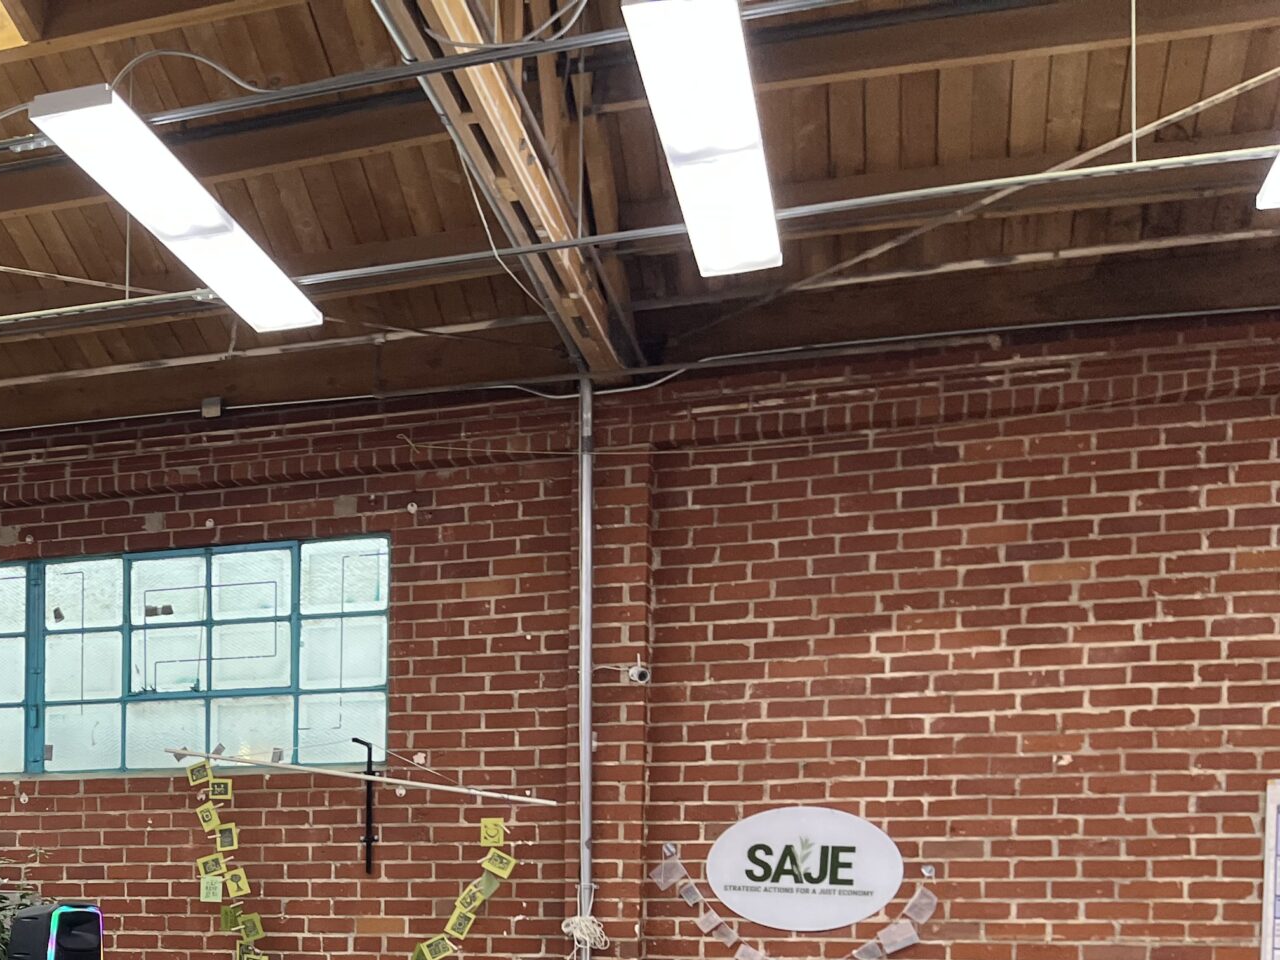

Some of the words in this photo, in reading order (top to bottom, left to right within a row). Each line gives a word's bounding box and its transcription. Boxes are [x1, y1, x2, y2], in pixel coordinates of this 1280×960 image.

[745, 843, 856, 885] SAJE
[723, 884, 761, 893] STRATEGIC
[763, 886, 794, 894] ACTIONS
[838, 889, 874, 897] ECONOMY
